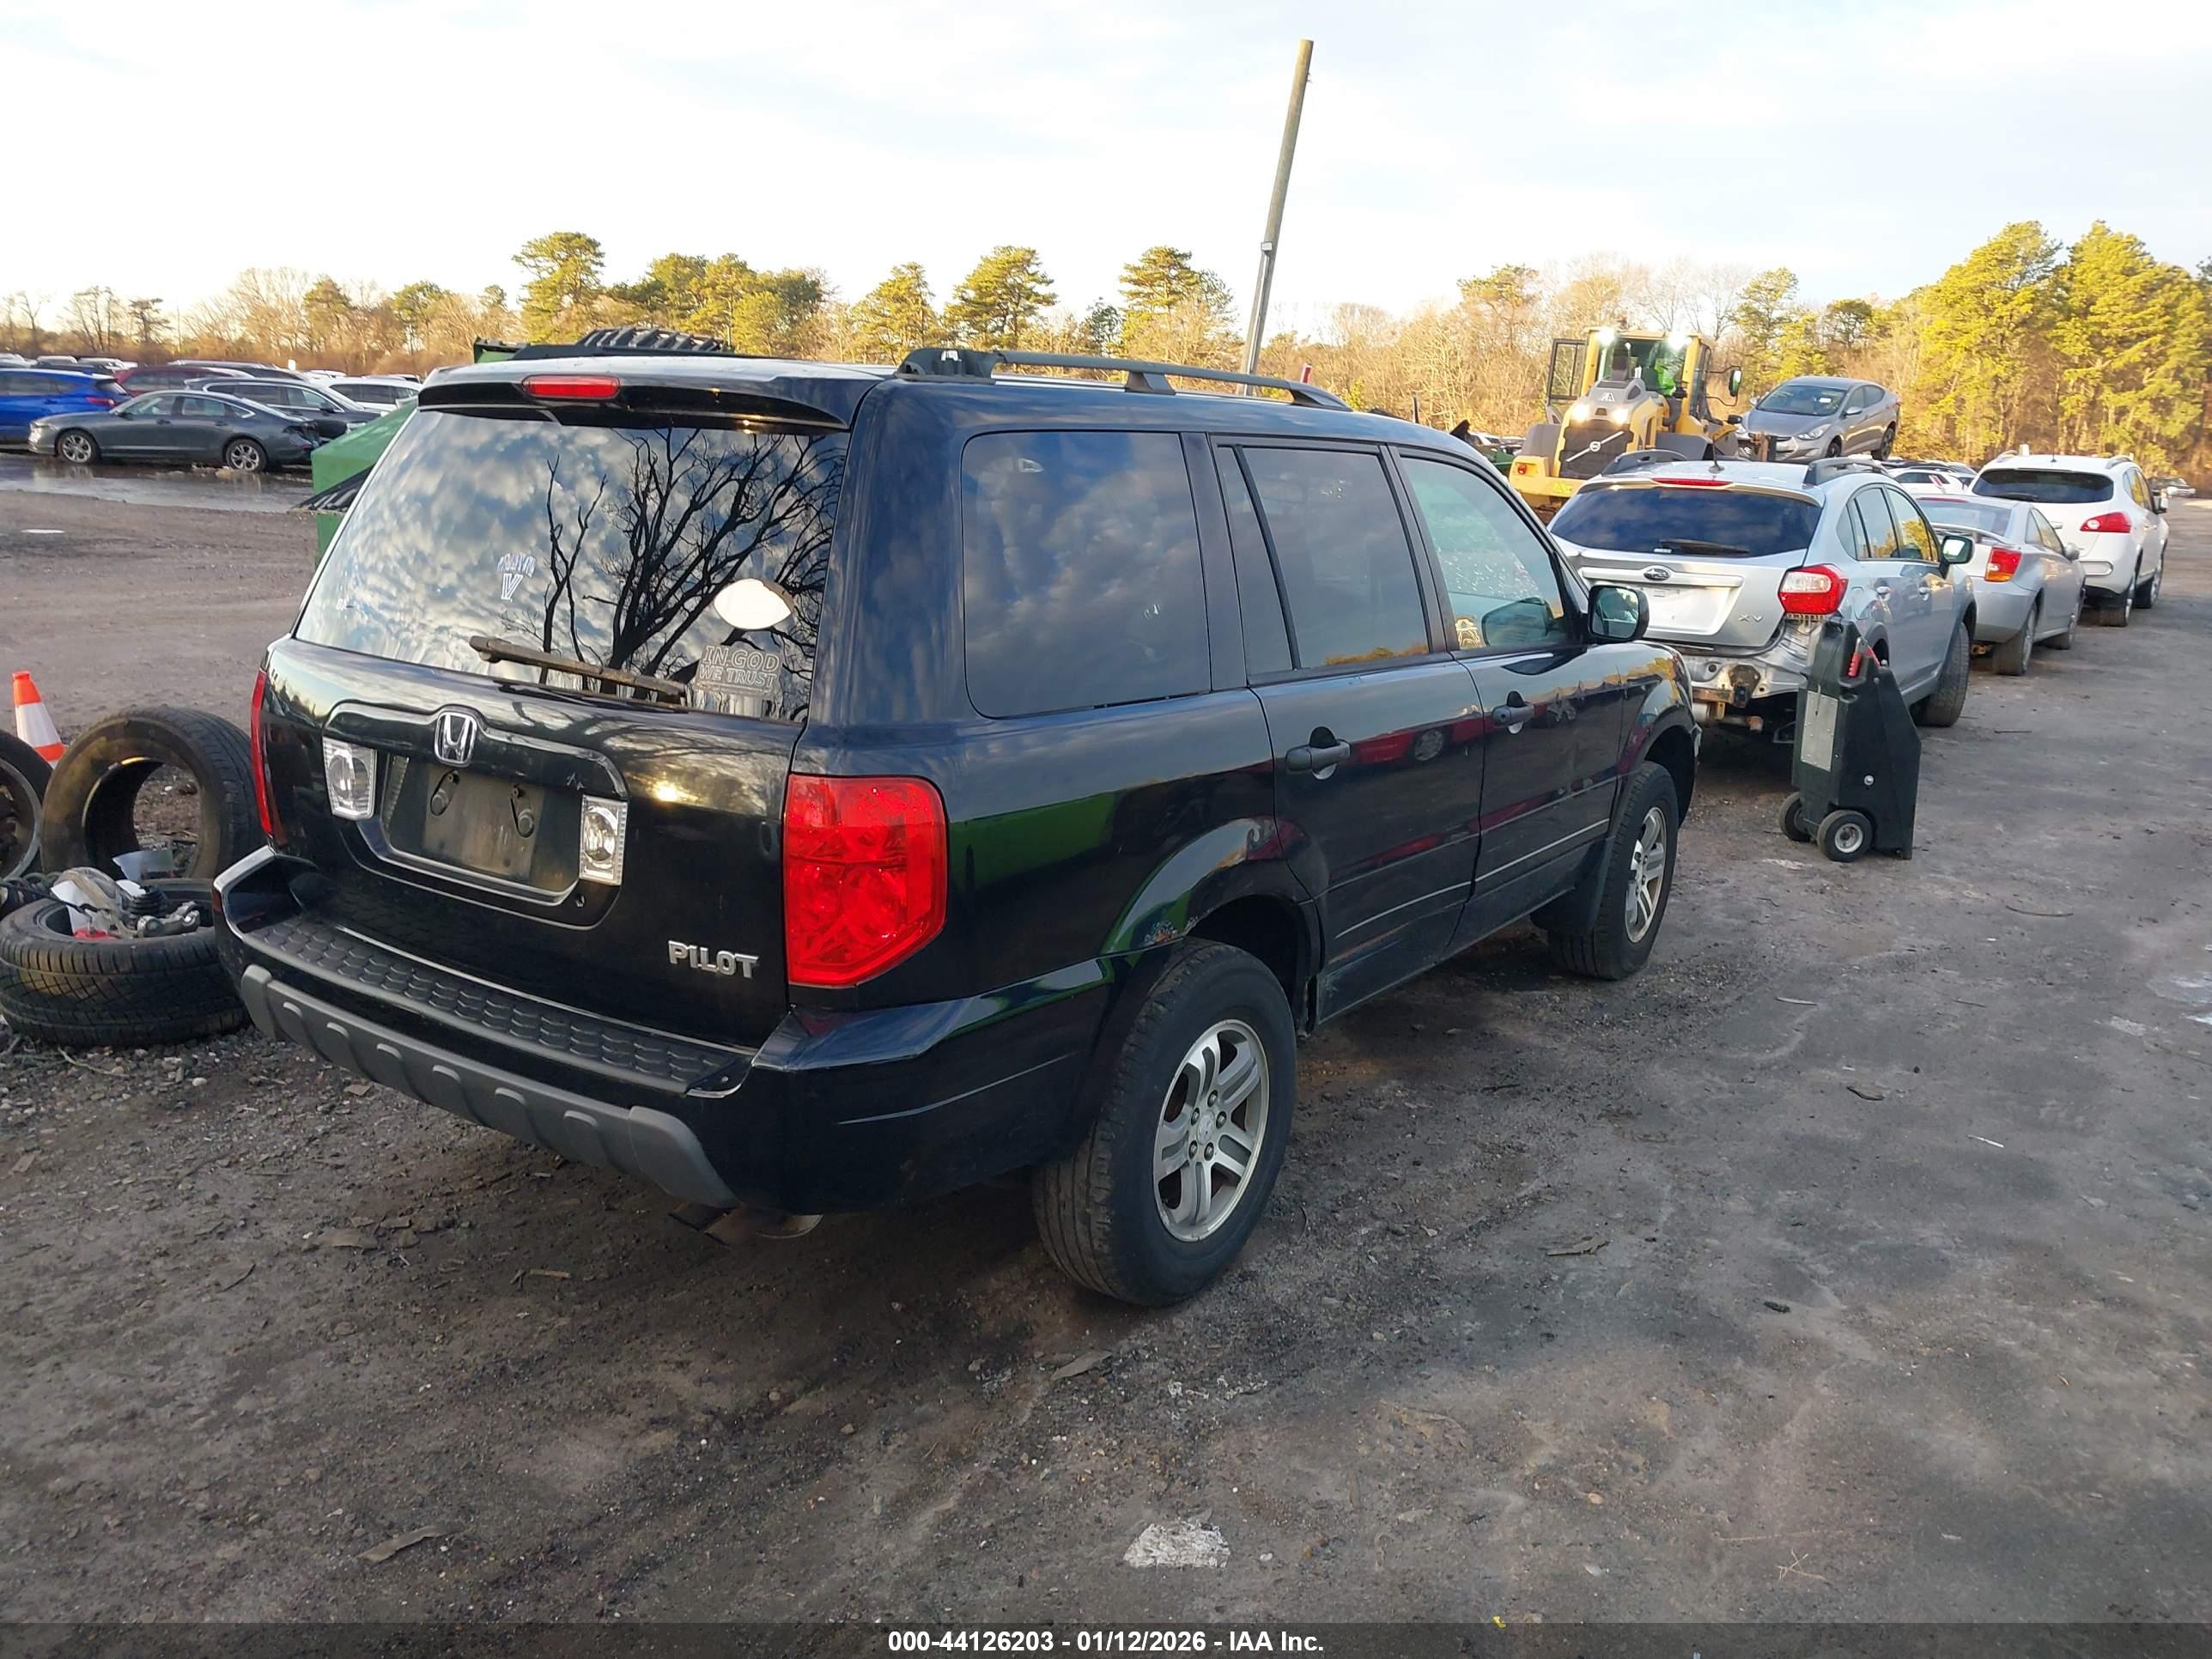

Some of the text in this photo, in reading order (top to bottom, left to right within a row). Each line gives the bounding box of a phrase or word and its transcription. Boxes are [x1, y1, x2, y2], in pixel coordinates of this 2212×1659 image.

[702, 645, 780, 672] IN GOD
[699, 664, 778, 688] WE TRUST
[668, 939, 759, 978] PILOT
